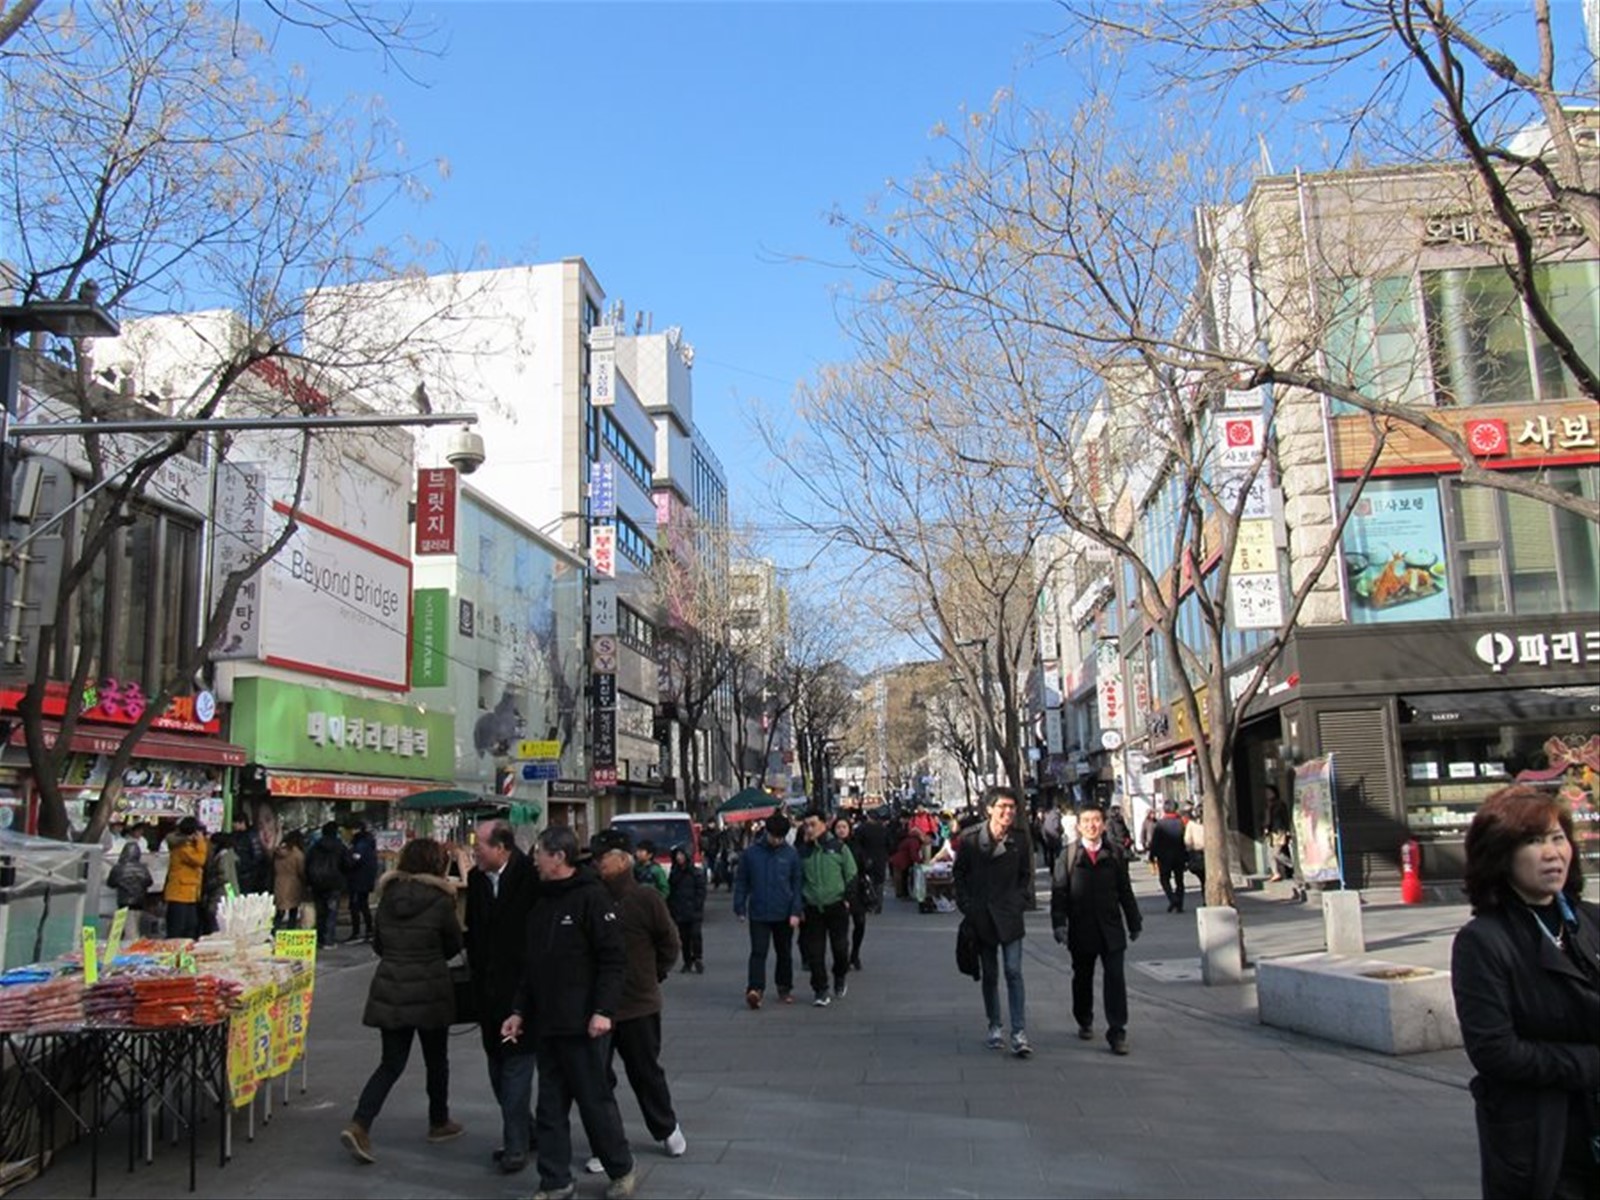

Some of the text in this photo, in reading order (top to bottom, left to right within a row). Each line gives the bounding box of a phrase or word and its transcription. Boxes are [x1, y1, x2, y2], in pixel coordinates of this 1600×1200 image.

[427, 471, 447, 534] 브릿지
[1384, 497, 1424, 511] 사보텐
[421, 538, 451, 551] 갤러리
[292, 550, 399, 616] Beyond Bridge
